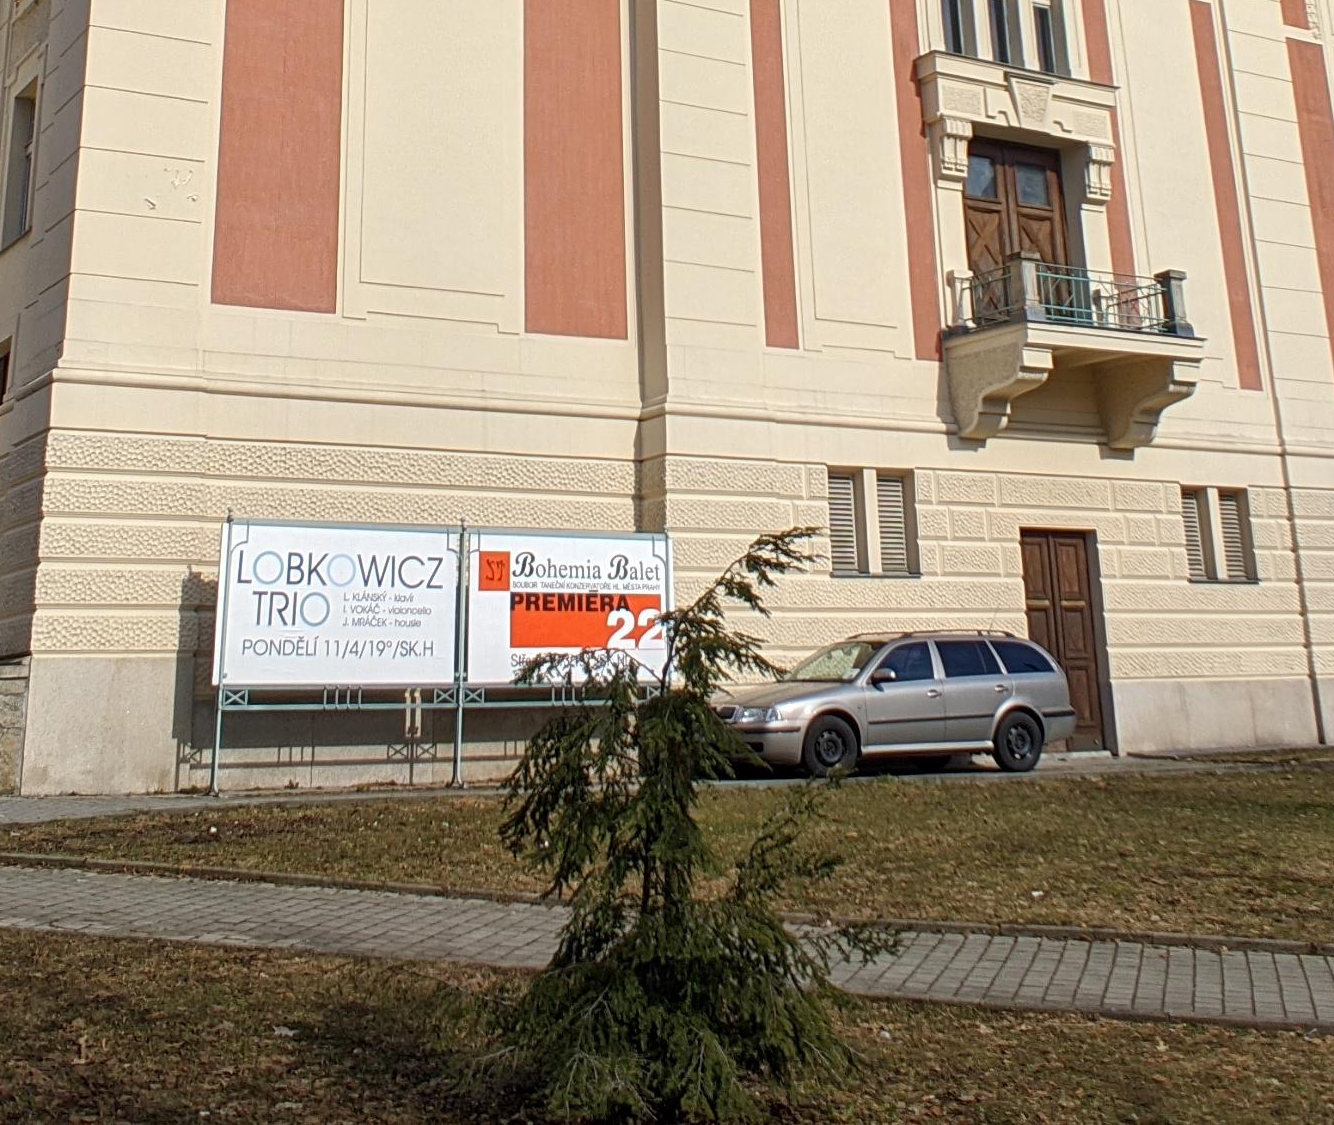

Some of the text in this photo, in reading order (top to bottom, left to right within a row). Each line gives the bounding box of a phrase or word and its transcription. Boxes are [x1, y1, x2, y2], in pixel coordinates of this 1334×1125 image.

[237, 550, 444, 589] LOBKOWICZ
[512, 551, 602, 580] Bohemia
[607, 554, 661, 581] Balet
[540, 580, 566, 590] TANEČNÍ
[352, 590, 387, 602] KLÁNSKÝ
[394, 592, 415, 603] klavír
[252, 591, 331, 627] TRIO
[350, 602, 381, 615] VOKÁČ
[388, 605, 432, 616] violoncello
[351, 615, 387, 628] MRÁČEK
[394, 618, 422, 628] housle
[606, 608, 666, 650] 22
[241, 635, 320, 657] PONDĚLÍ
